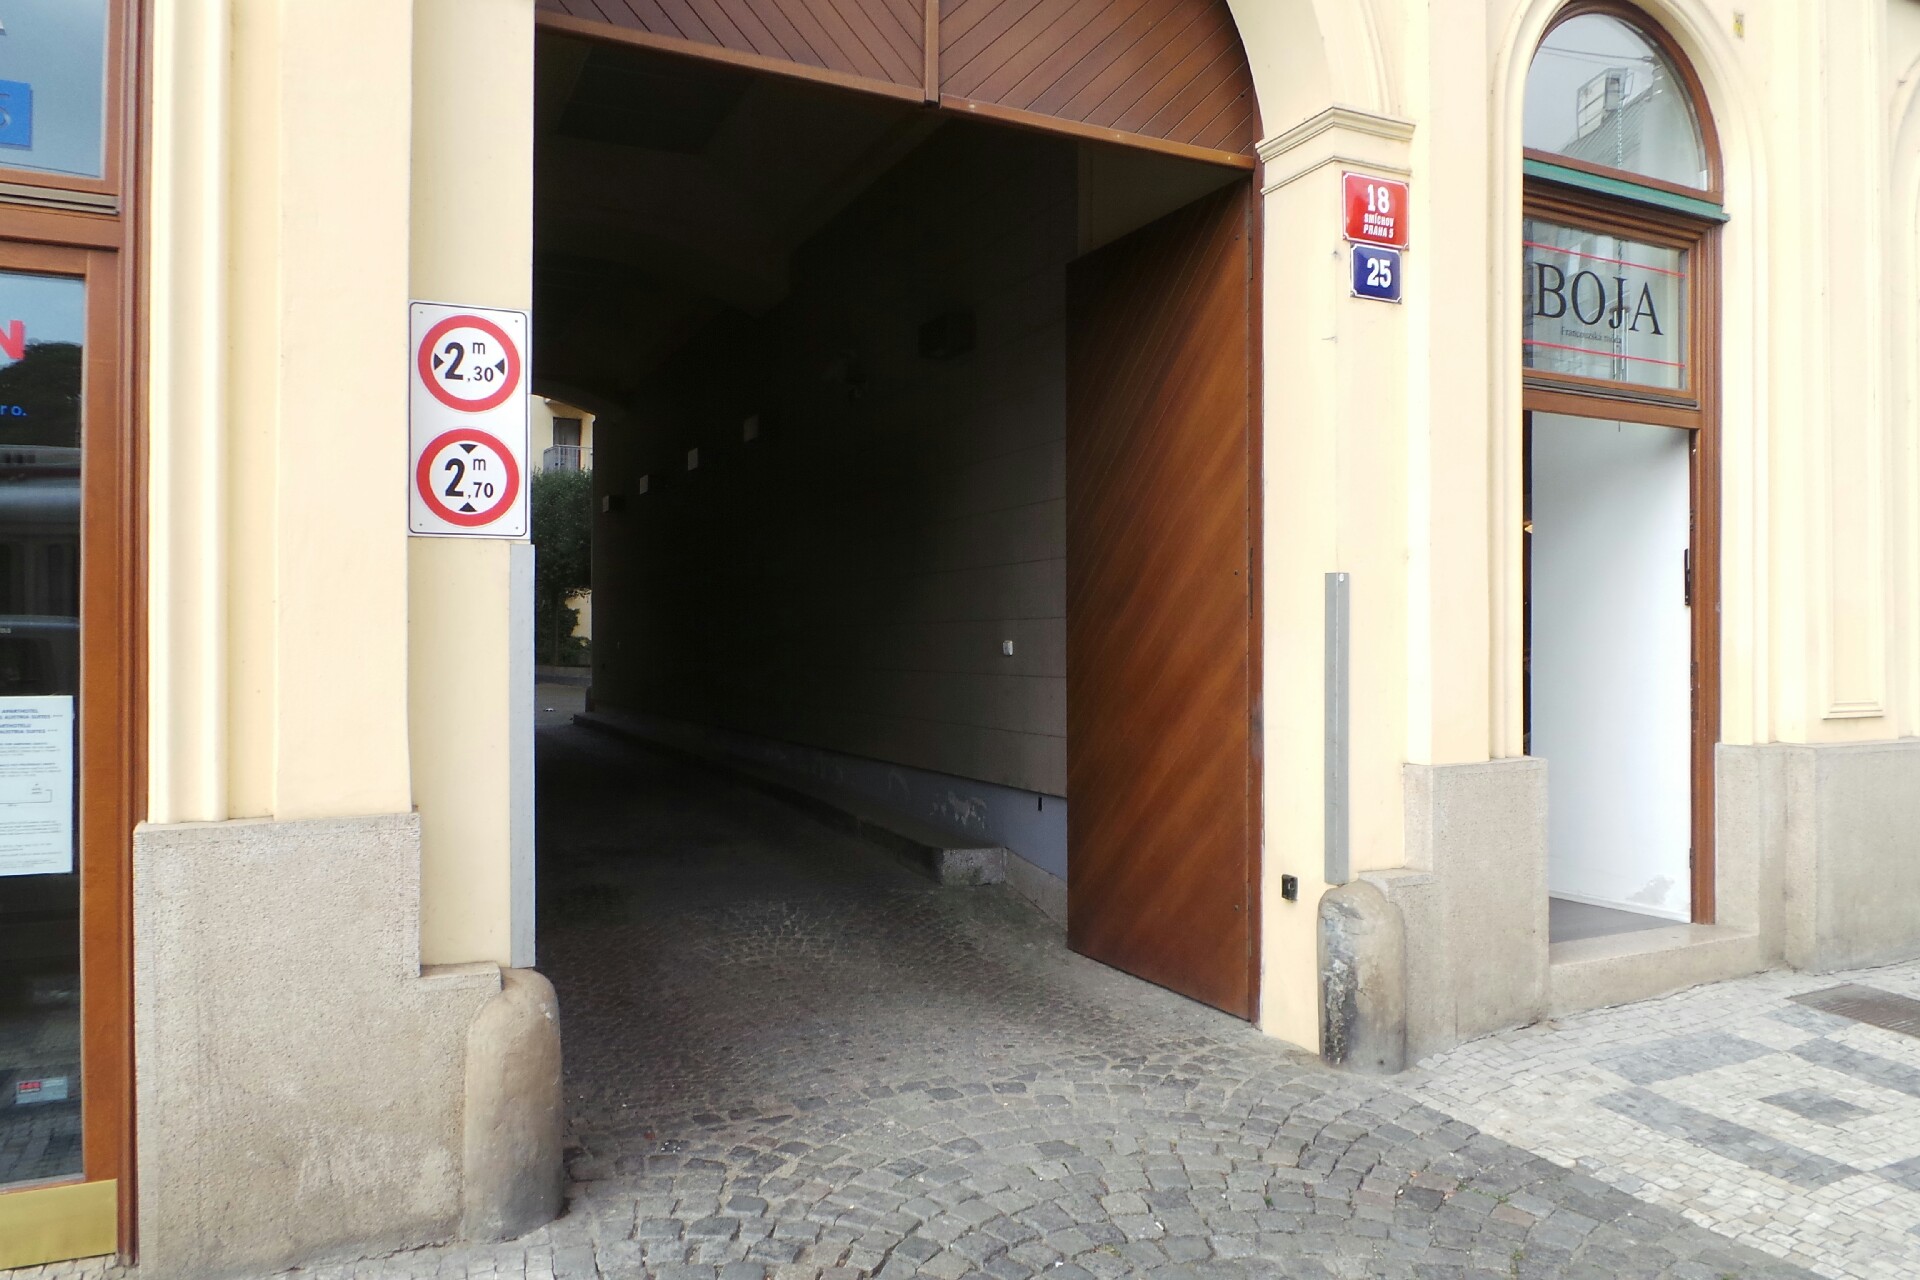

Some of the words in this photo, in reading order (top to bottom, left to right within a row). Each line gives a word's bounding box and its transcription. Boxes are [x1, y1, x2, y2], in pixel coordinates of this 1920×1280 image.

[1367, 184, 1390, 214] 18
[1363, 212, 1395, 227] SMÍCHOV
[1362, 224, 1388, 238] PRAHA
[1388, 228, 1394, 239] 5
[1366, 257, 1392, 288] 25
[1533, 262, 1664, 336] BOJA
[472, 342, 486, 355] m
[472, 458, 486, 471] m
